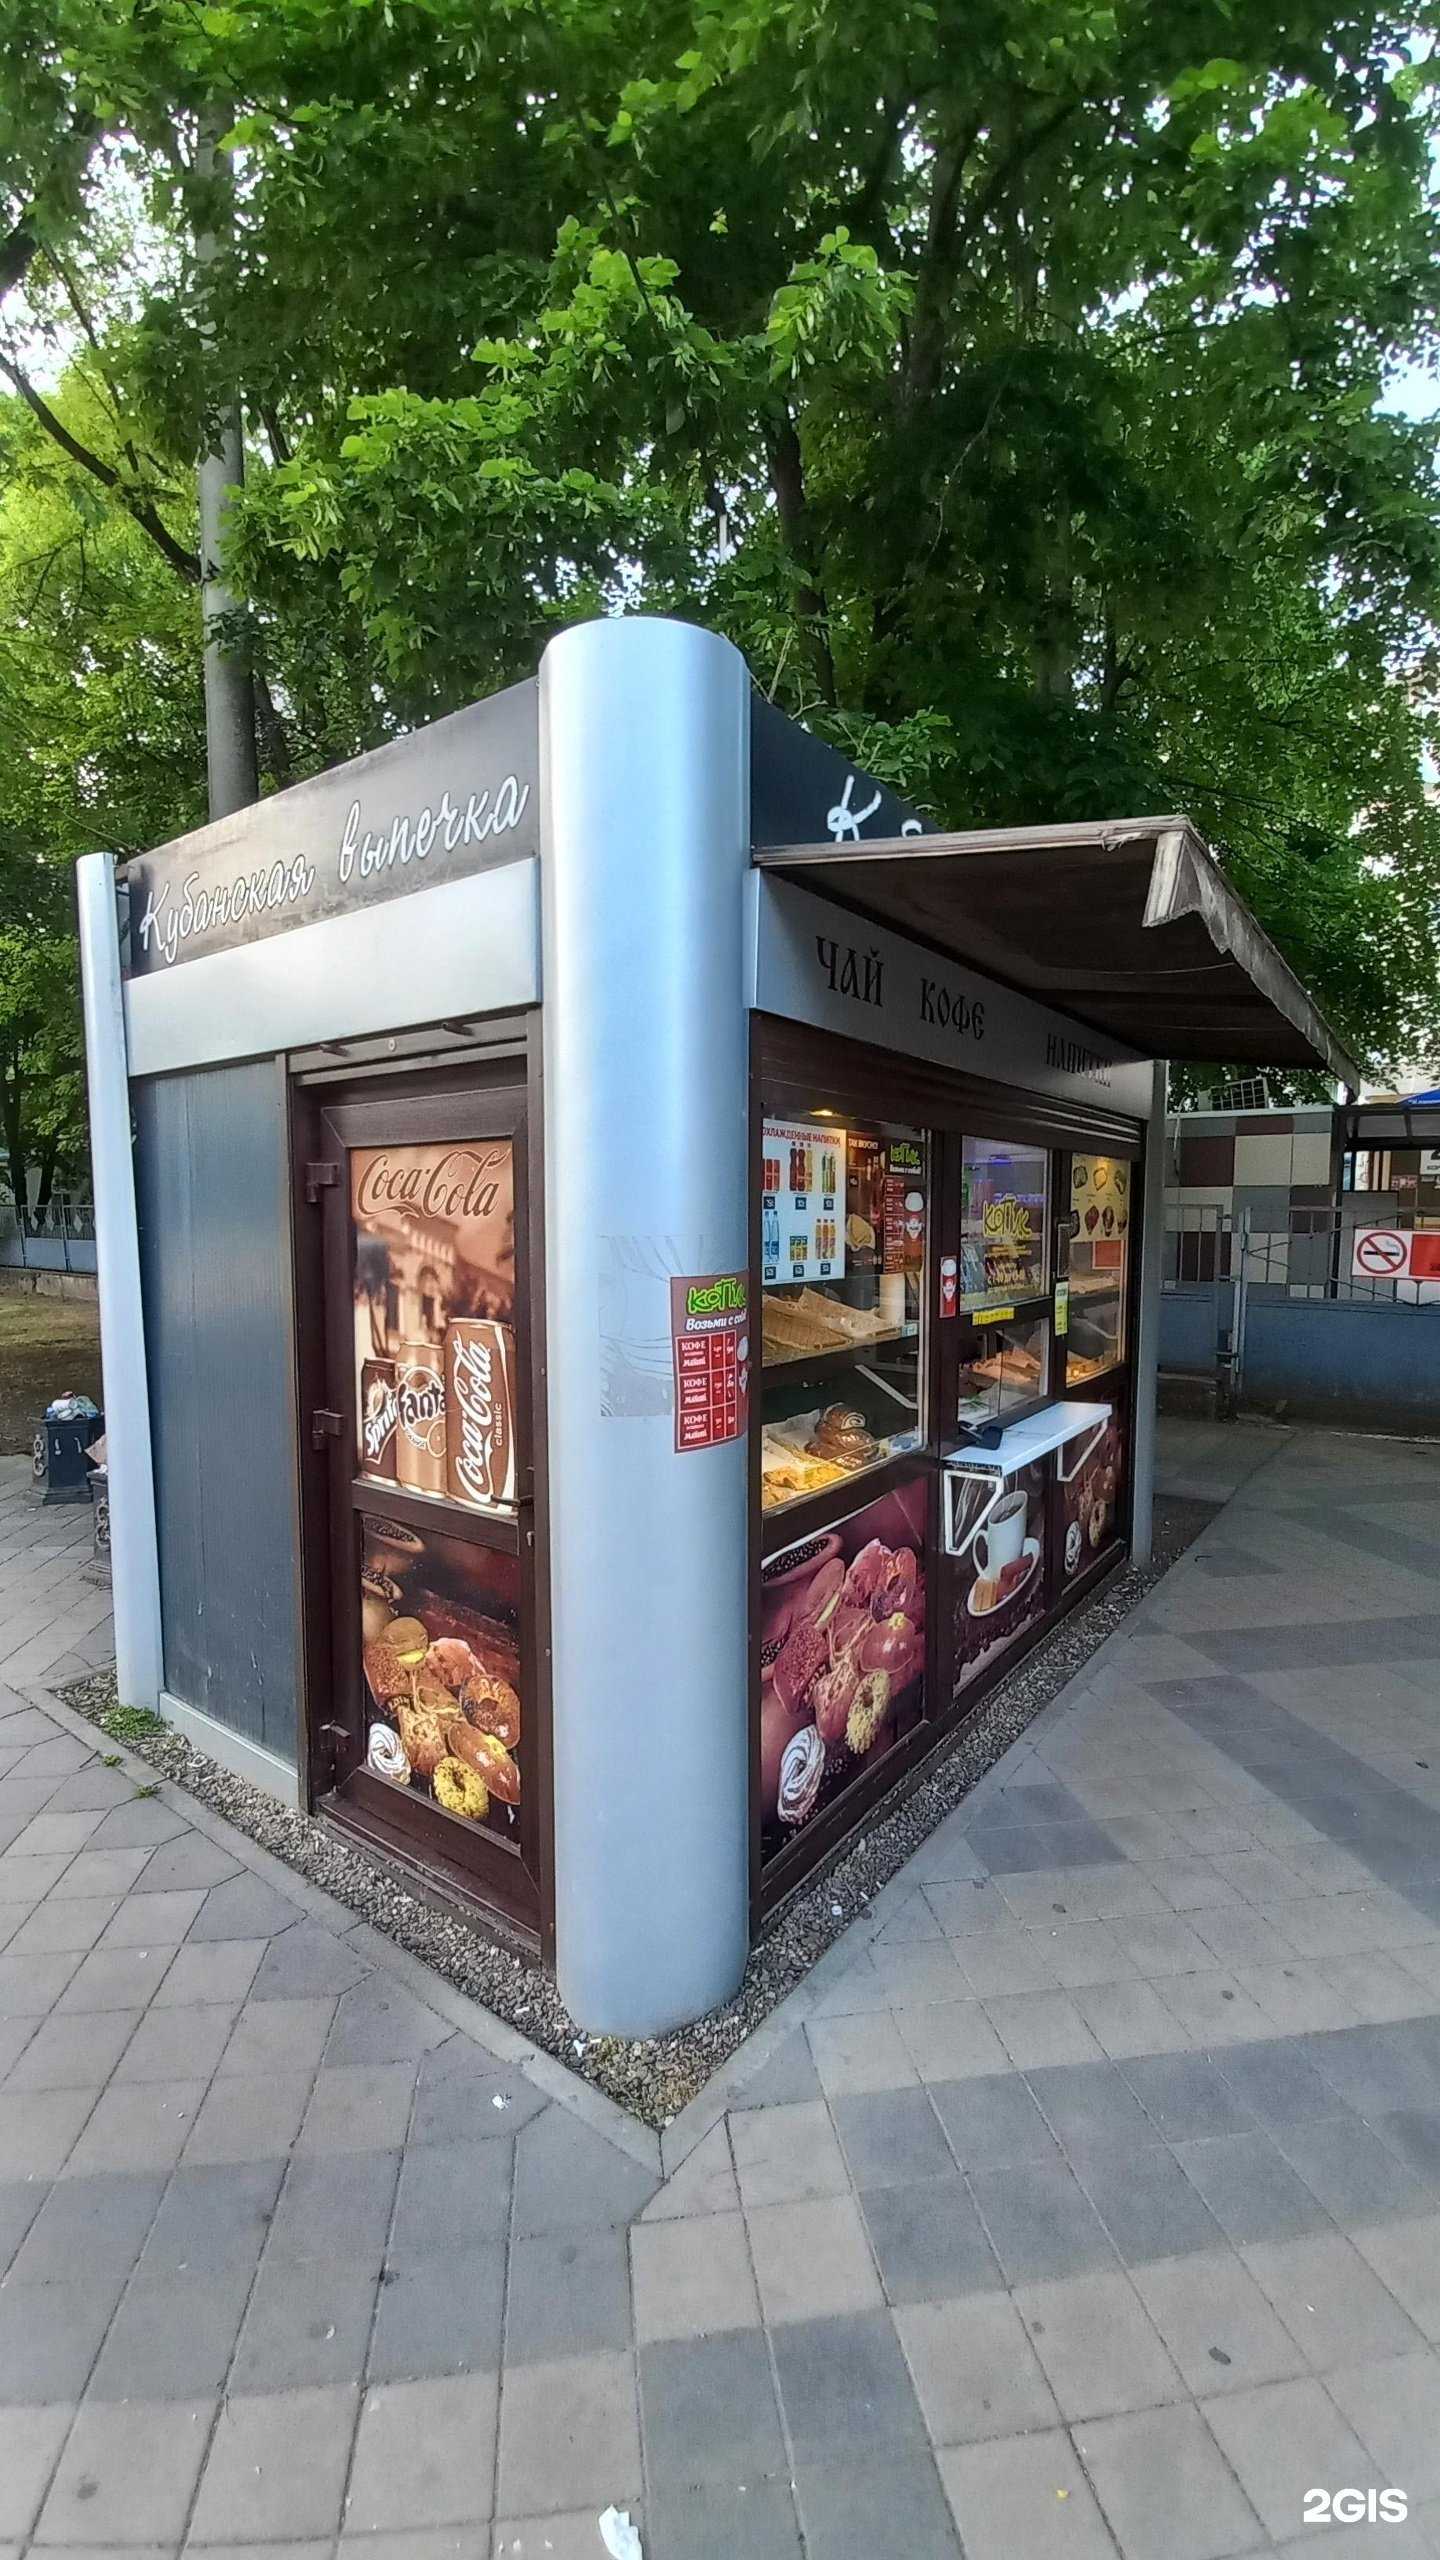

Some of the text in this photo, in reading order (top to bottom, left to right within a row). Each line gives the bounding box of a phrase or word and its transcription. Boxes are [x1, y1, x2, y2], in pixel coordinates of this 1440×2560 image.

[139, 775, 531, 964] Кубанская выпечка
[815, 935, 885, 1008] ЧАЙ
[919, 977, 985, 1040] КОФЕ
[357, 1150, 511, 1218] Coca-Cola
[681, 1340, 706, 1351] КОФЕ
[683, 1377, 708, 1388] КОФЕ
[365, 1391, 398, 1457] Sprit
[453, 1330, 493, 1503] Coca-Cola
[493, 1403, 503, 1447] classic
[683, 1414, 708, 1425] КОФЕ
